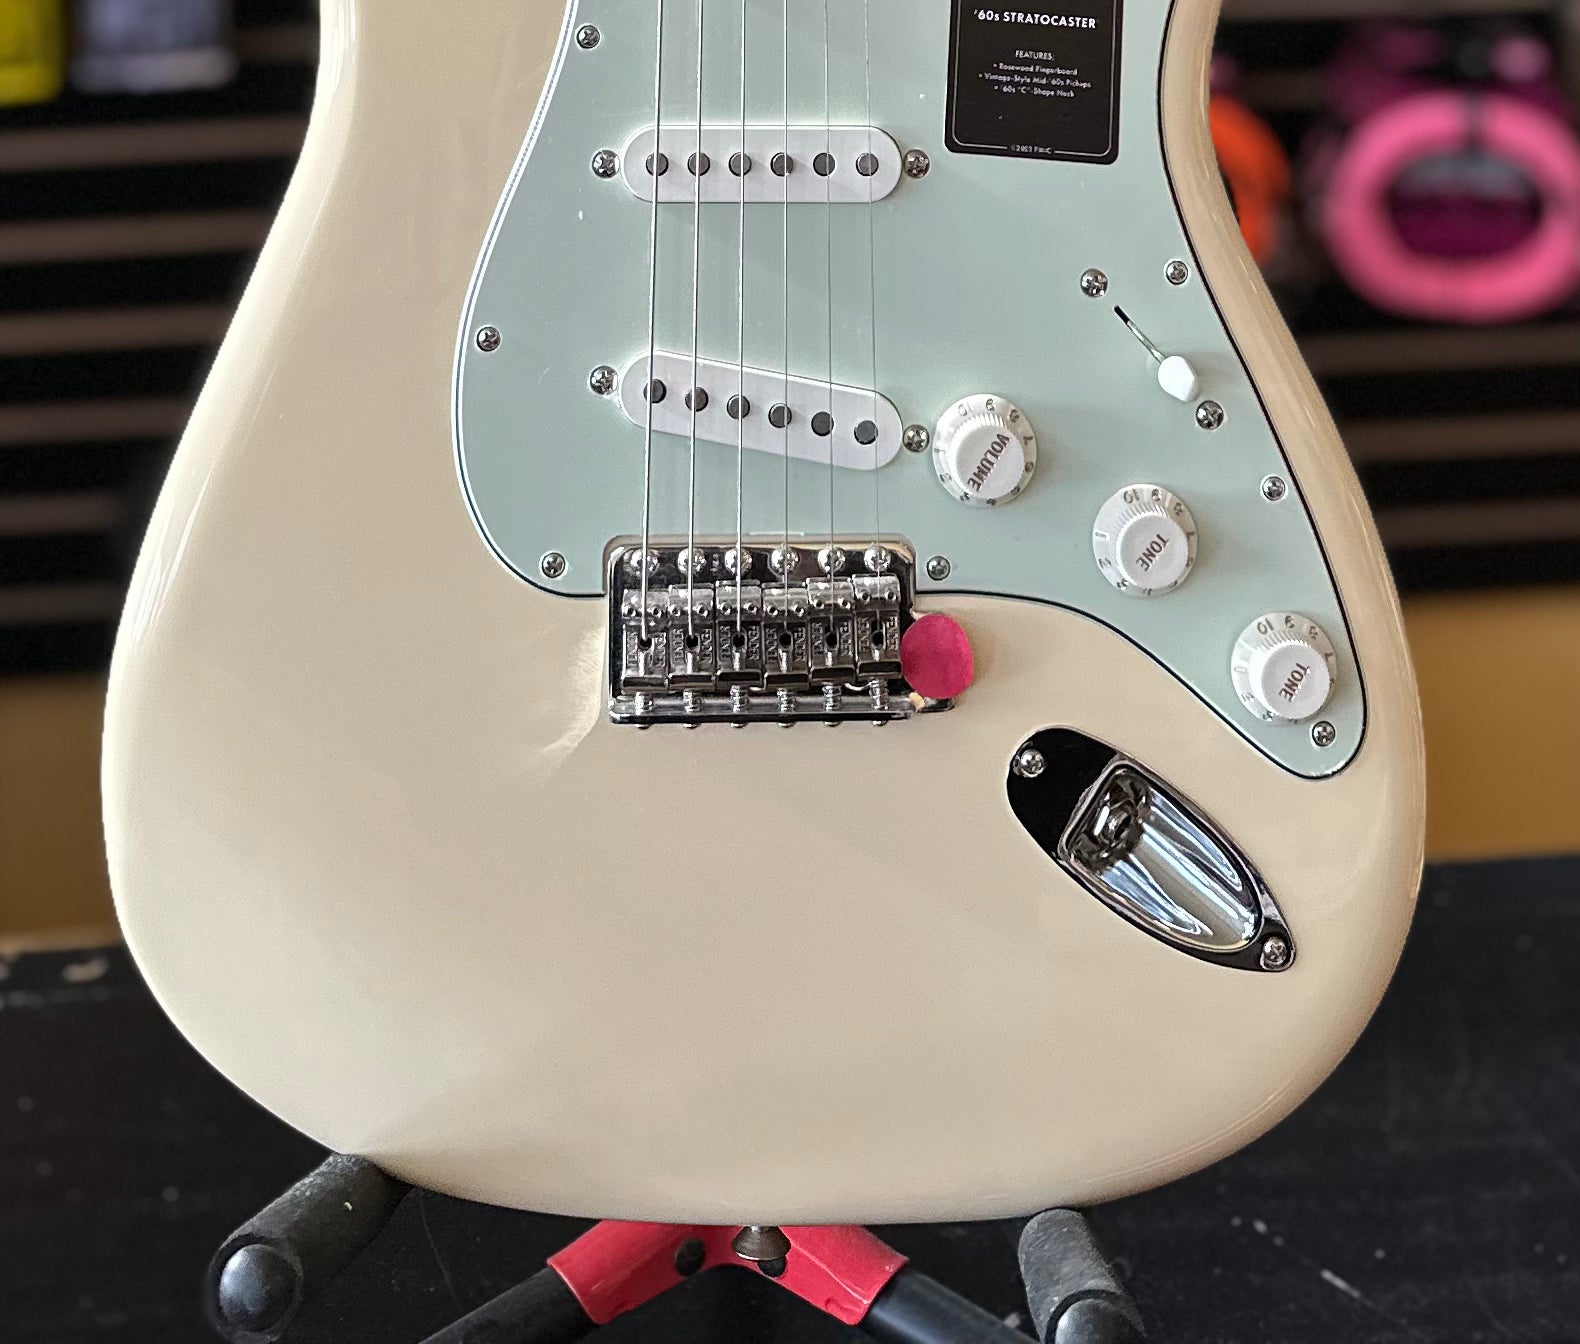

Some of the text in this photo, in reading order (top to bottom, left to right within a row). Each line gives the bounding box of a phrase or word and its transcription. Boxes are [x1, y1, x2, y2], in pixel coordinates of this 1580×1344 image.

[1002, 11, 1096, 29] STRATOCASTER
[966, 433, 1010, 492] VOLUME
[1136, 533, 1170, 572] TONE
[1278, 662, 1310, 703] TONE
